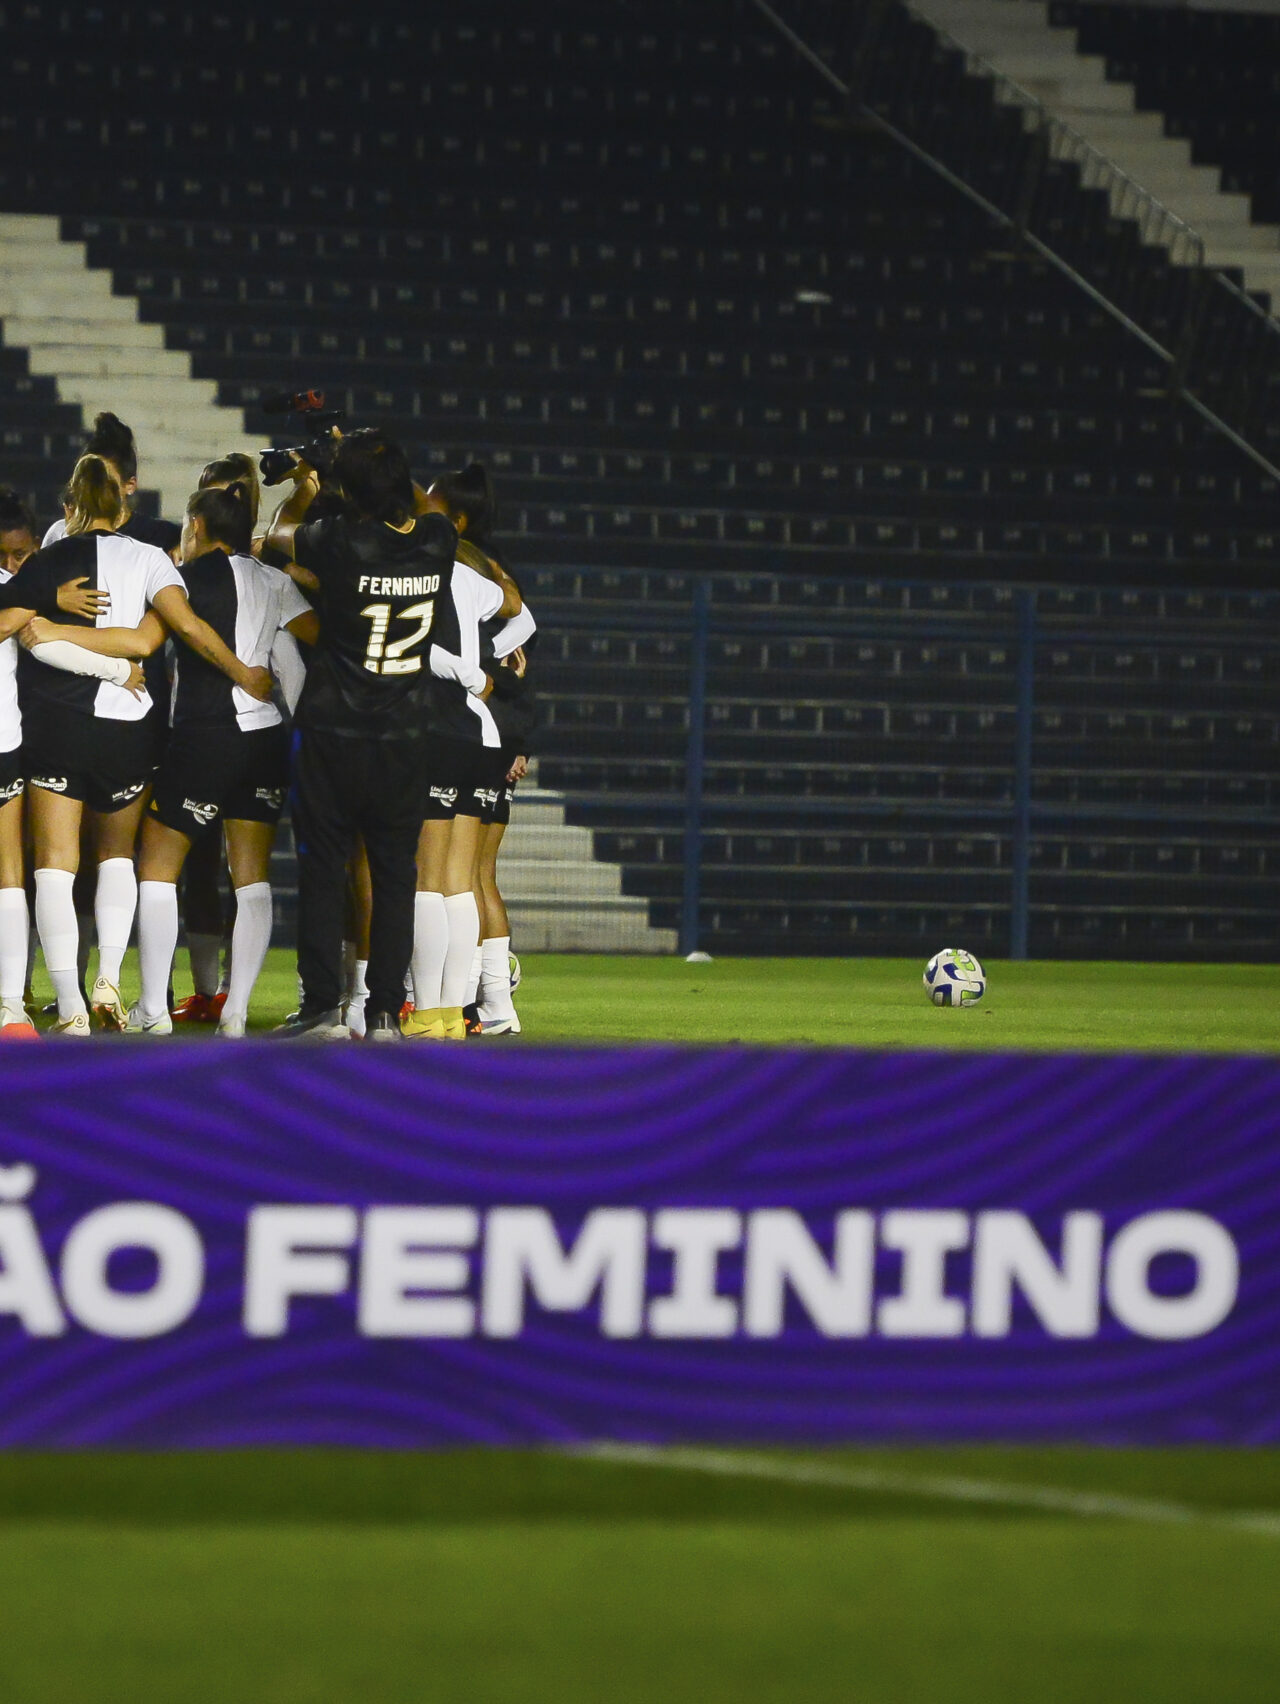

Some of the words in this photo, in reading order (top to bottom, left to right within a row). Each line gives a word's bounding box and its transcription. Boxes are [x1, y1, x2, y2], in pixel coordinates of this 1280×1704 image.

[358, 575, 440, 596] FERNANDO
[360, 600, 434, 675] 12
[245, 1207, 1237, 1337] FEMININO
